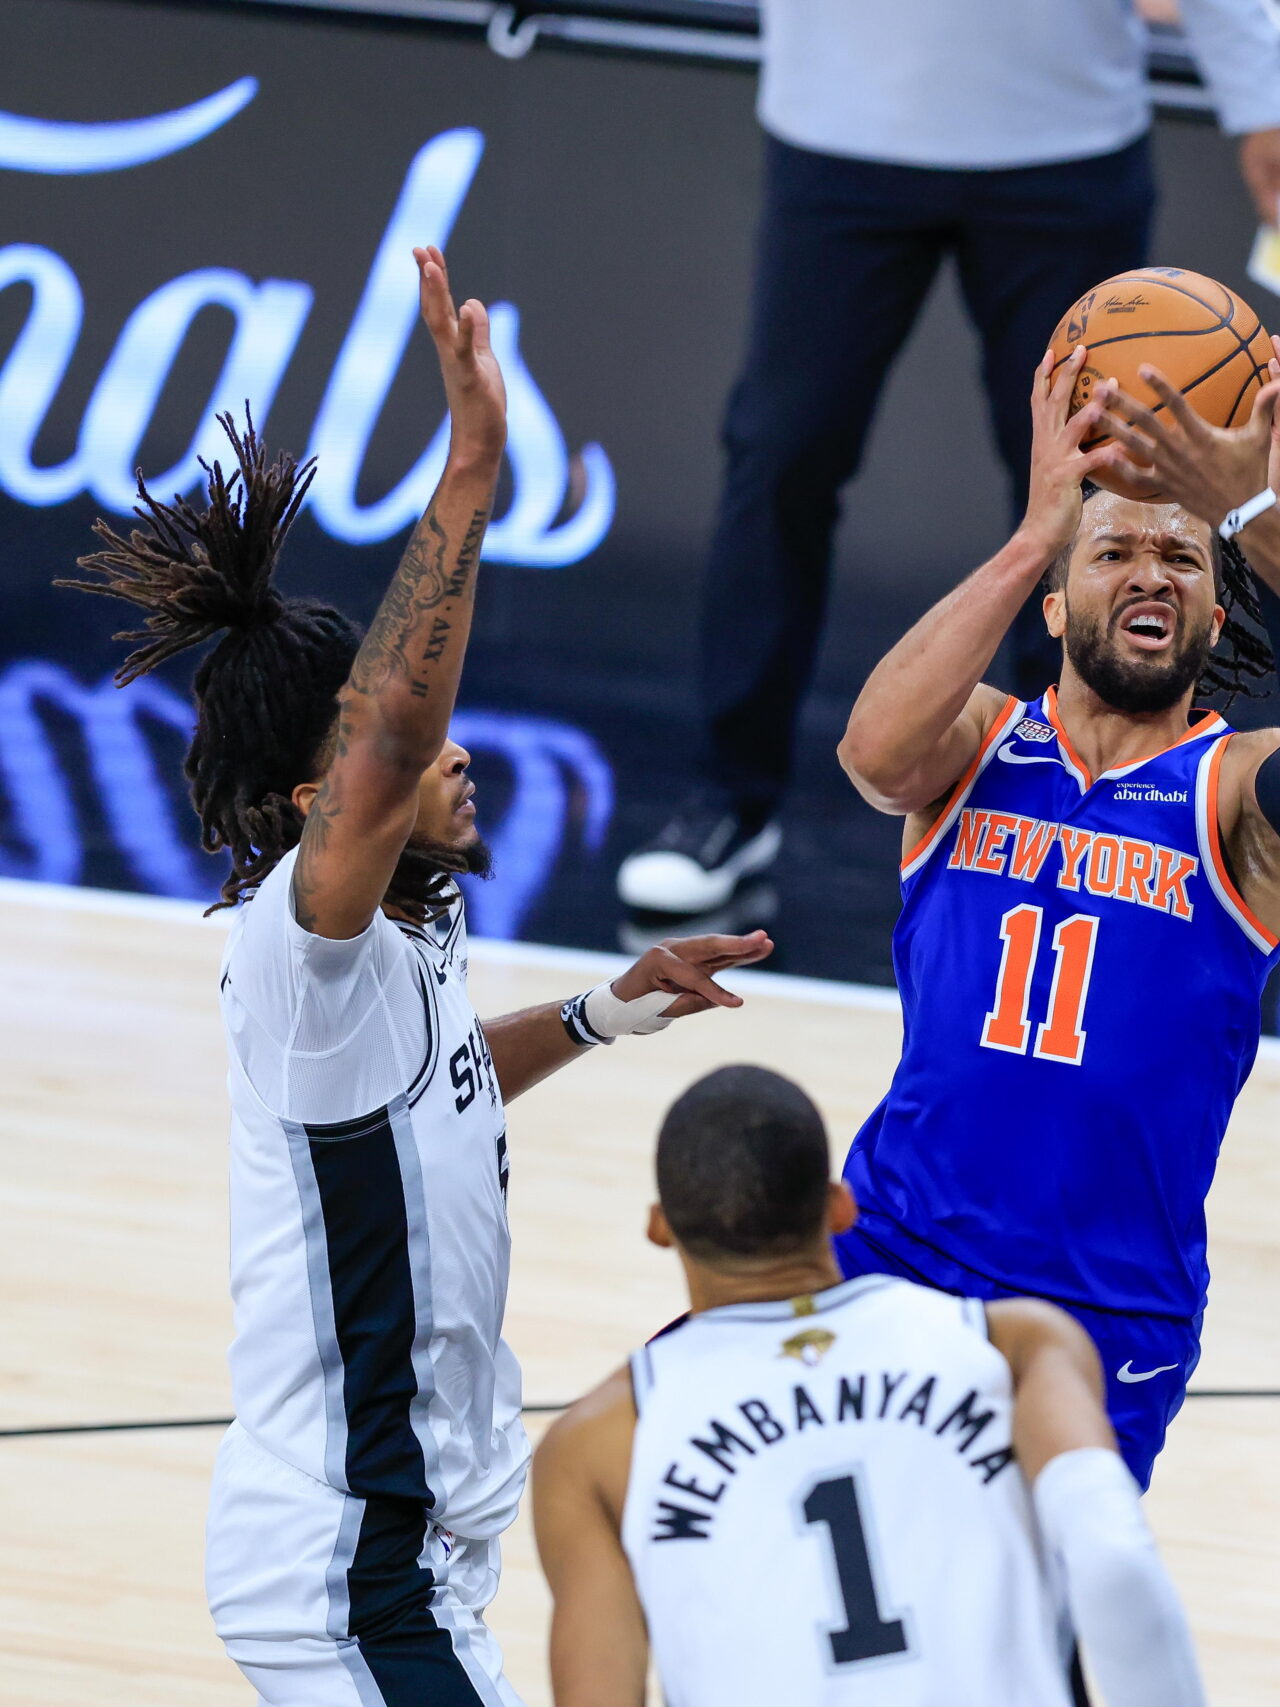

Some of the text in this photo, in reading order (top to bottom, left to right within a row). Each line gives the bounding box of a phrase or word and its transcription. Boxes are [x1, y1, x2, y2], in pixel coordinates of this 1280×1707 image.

[947, 808, 1199, 923] NEW YORK
[1113, 788, 1142, 801] abu
[979, 902, 1100, 1066] 11
[652, 1372, 1018, 1543] WEMBANYAMA
[793, 1463, 919, 1674] 1
